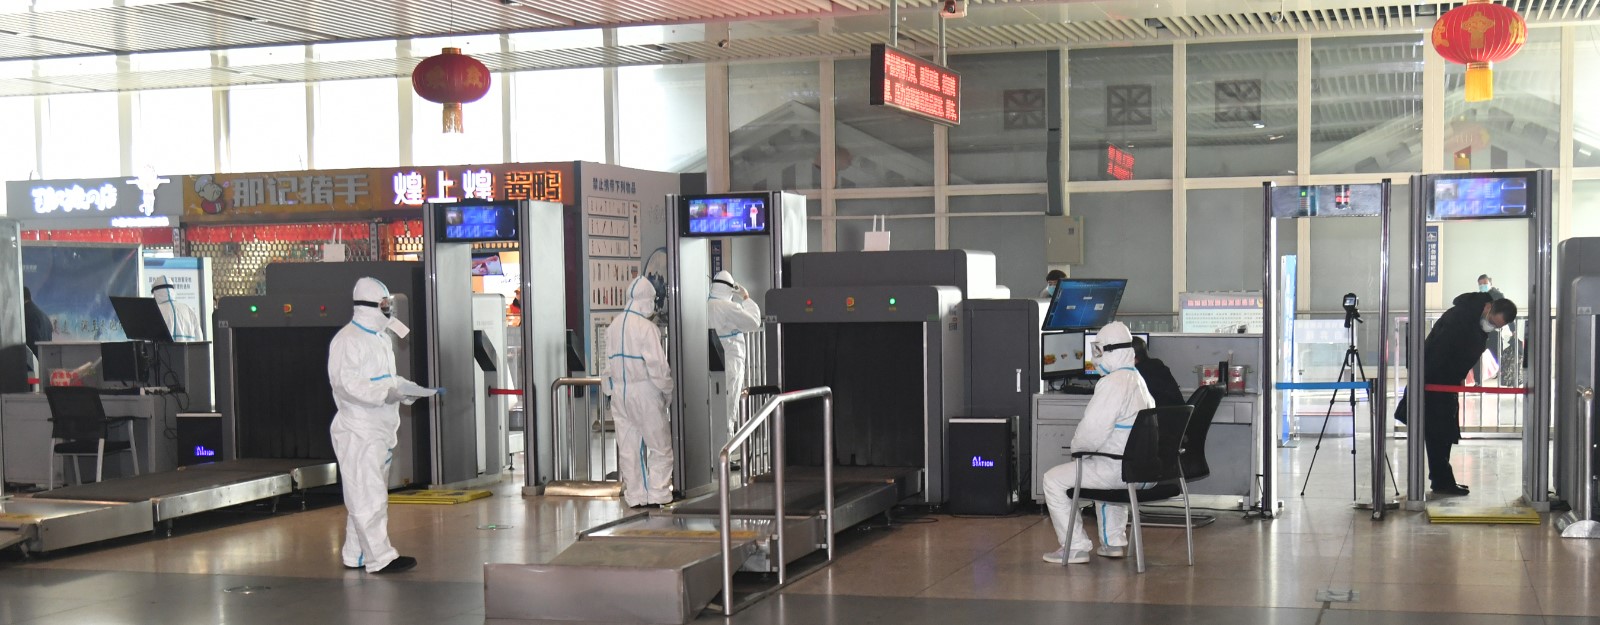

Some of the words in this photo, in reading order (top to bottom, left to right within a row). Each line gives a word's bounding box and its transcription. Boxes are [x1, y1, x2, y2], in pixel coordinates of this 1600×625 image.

[233, 174, 368, 207] 那记猪手
[393, 169, 494, 205] 煌上煌
